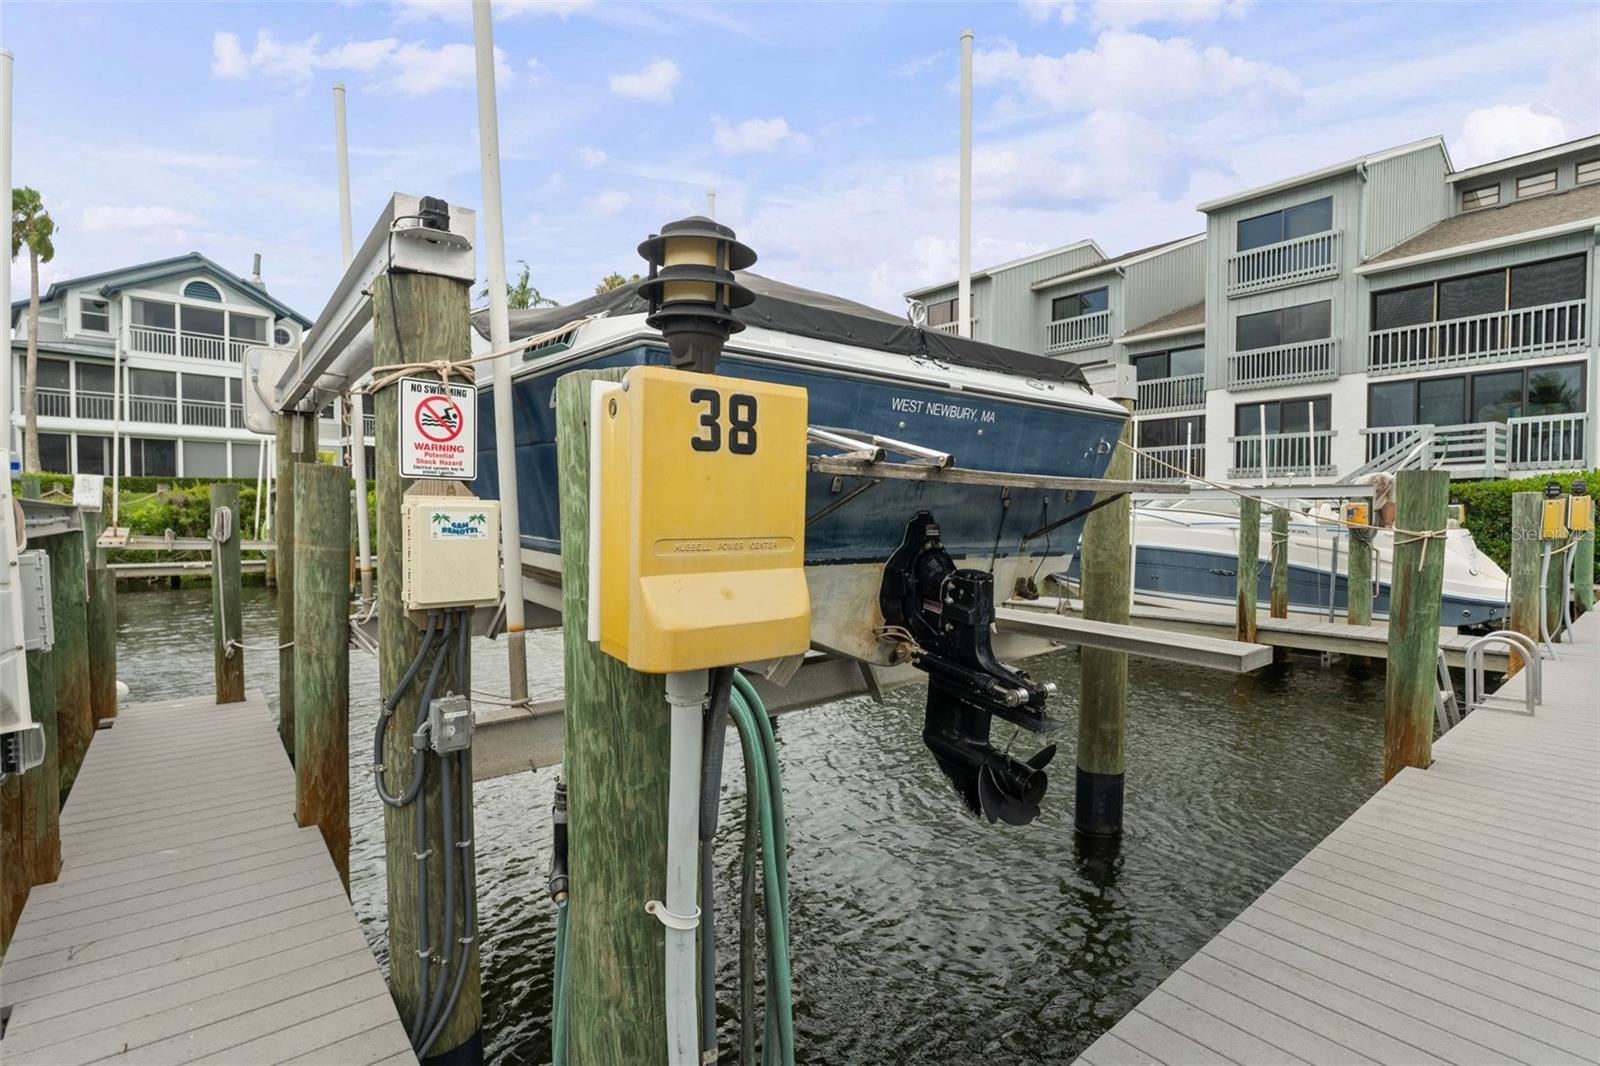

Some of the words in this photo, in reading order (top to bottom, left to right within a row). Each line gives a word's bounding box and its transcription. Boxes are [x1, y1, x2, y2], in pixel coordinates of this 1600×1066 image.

[411, 383, 422, 393] NO
[891, 397, 924, 413] WEST
[926, 402, 978, 423] NEWBURY,
[980, 410, 996, 423] MA
[690, 388, 757, 455] 38
[414, 442, 464, 453] WARNING
[717, 541, 745, 551] POWER
[749, 540, 777, 550] CENTER
